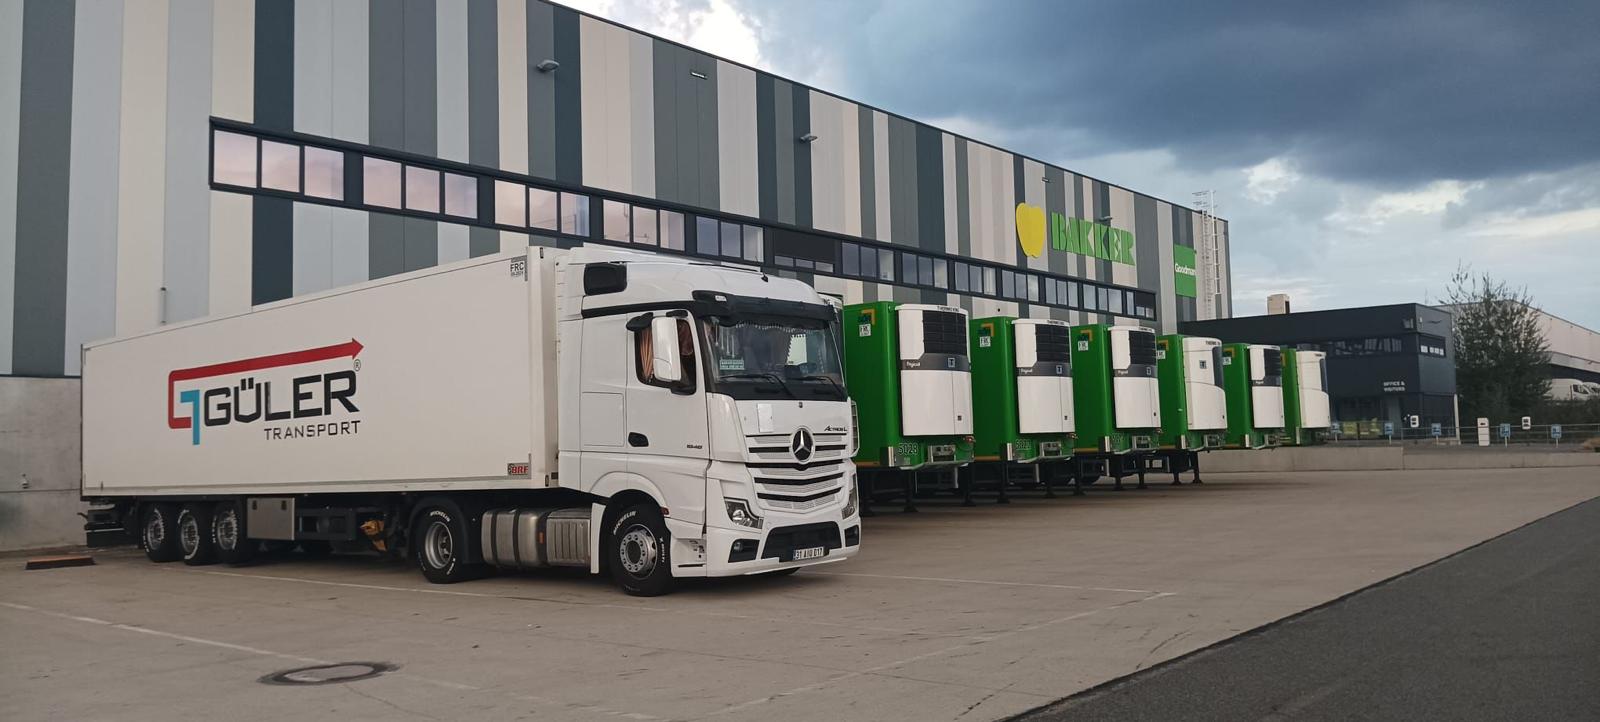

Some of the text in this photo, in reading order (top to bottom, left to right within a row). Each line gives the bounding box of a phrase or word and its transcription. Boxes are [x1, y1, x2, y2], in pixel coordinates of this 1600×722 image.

[1051, 212, 1136, 266] BAKKER
[510, 261, 524, 271] FRC
[204, 369, 360, 427] GÜLER
[264, 420, 361, 441] TRANSPORT
